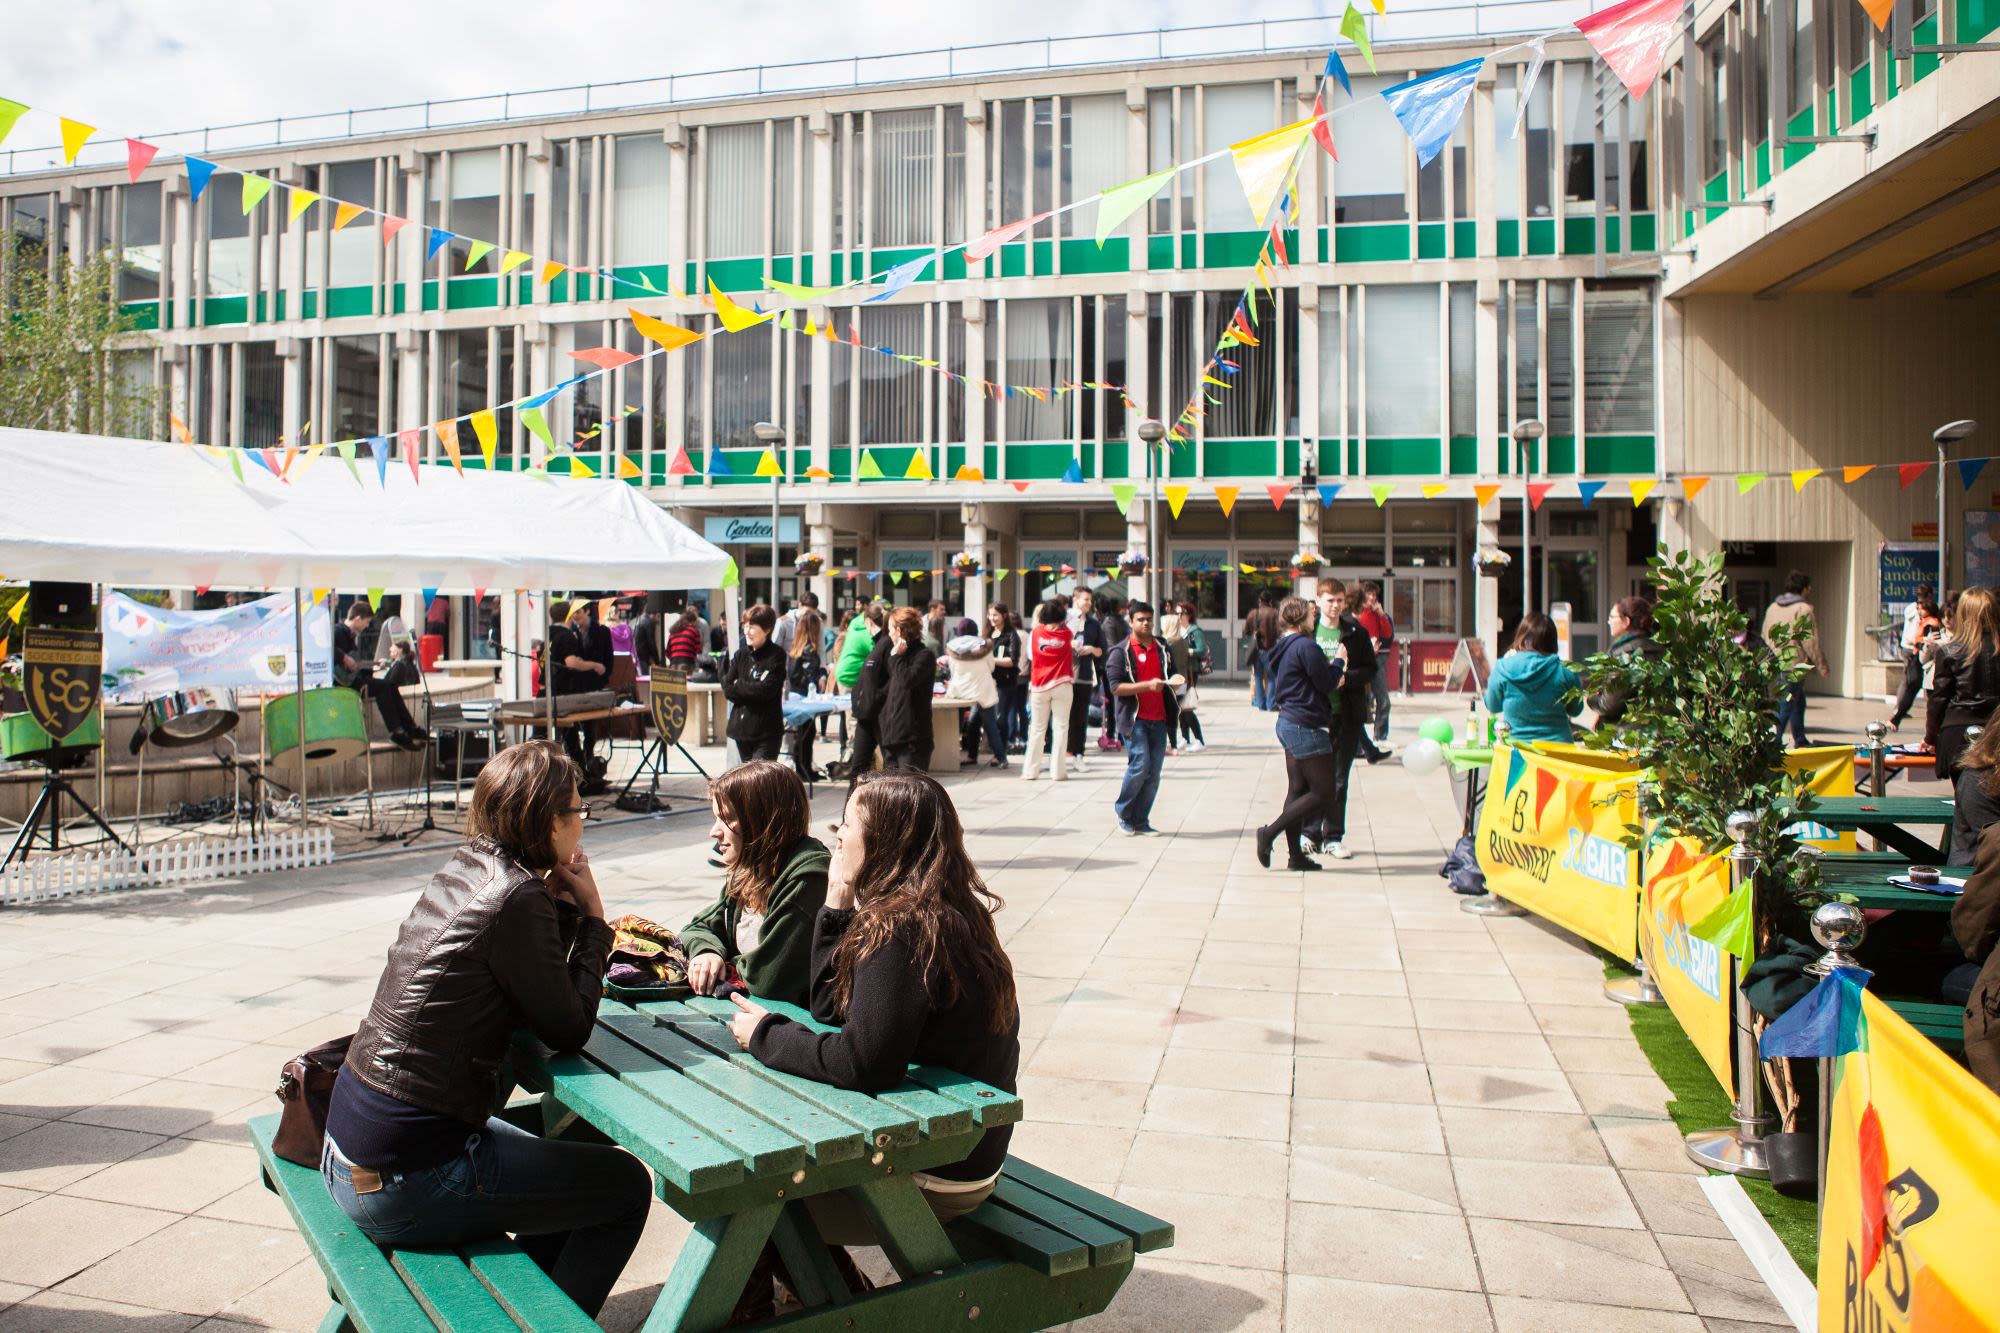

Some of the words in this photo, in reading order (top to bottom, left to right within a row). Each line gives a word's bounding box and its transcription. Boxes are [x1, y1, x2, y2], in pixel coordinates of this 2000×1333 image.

[1884, 553, 1914, 570] Stay
[1884, 582, 1909, 600] day
[49, 667, 91, 713] SG
[664, 696, 684, 729] SG
[1490, 829, 1556, 884] BULMERS
